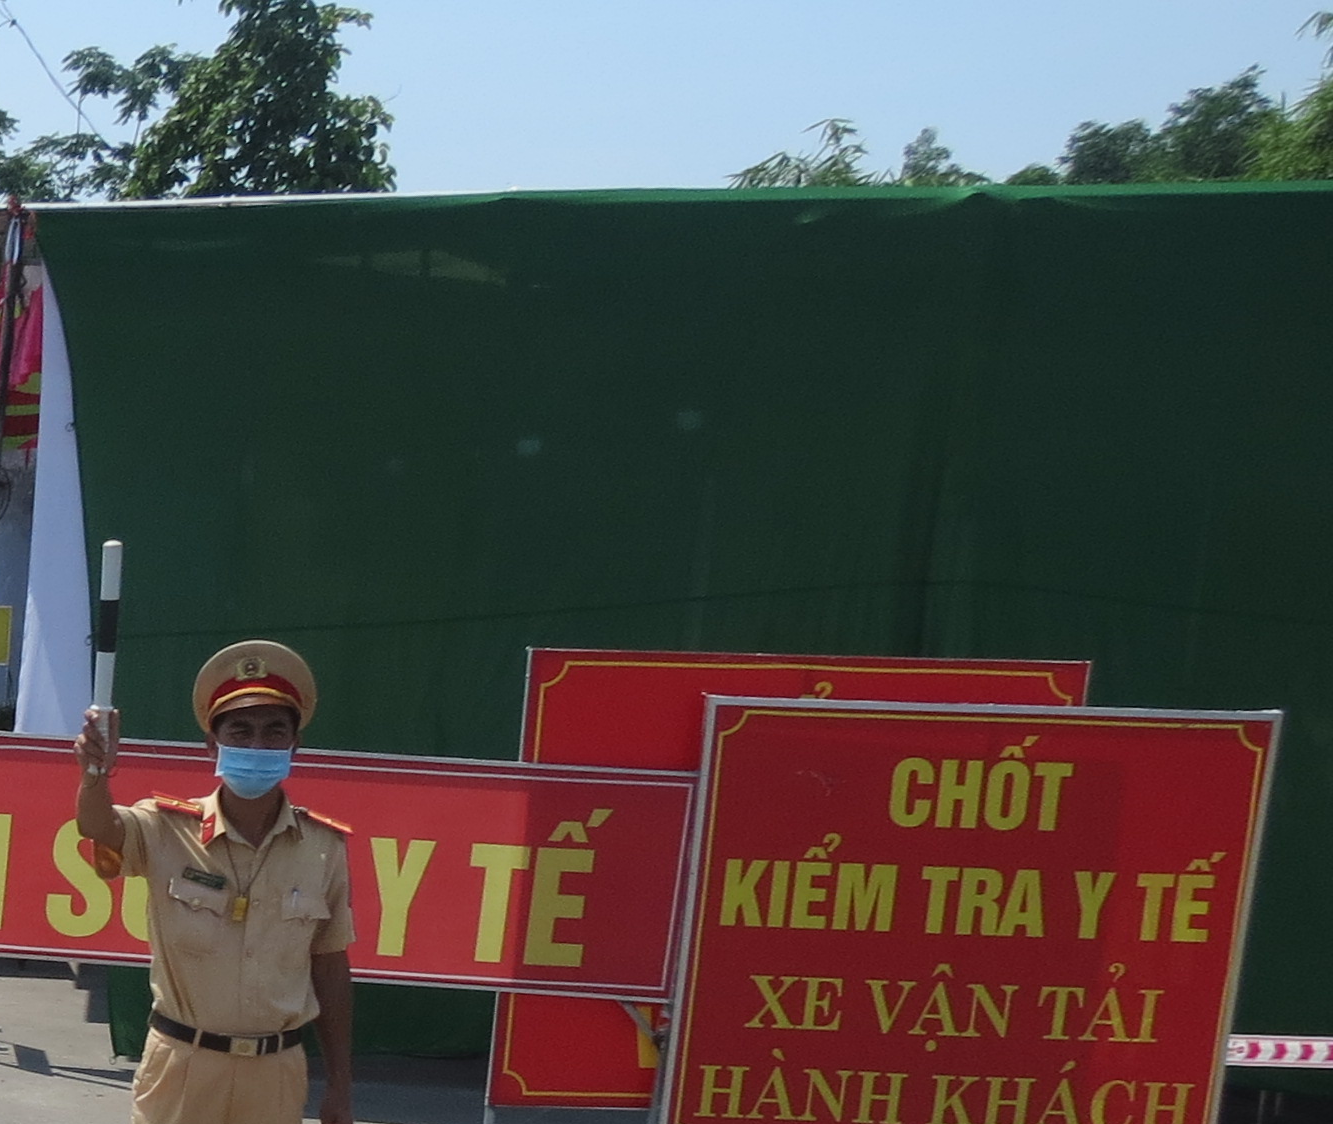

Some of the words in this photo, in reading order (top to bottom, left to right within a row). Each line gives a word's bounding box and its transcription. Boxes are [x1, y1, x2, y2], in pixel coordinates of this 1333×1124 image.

[888, 735, 1075, 832] CHỐT
[371, 837, 437, 957] Y
[471, 808, 610, 967] TẾ
[719, 832, 899, 934] KIỂM
[922, 866, 1045, 940] TRA
[1076, 870, 1116, 941] Y
[1137, 852, 1227, 944] TẾ
[745, 974, 844, 1032] XE
[865, 962, 1020, 1053] VẬN
[1039, 962, 1164, 1044] TẢI
